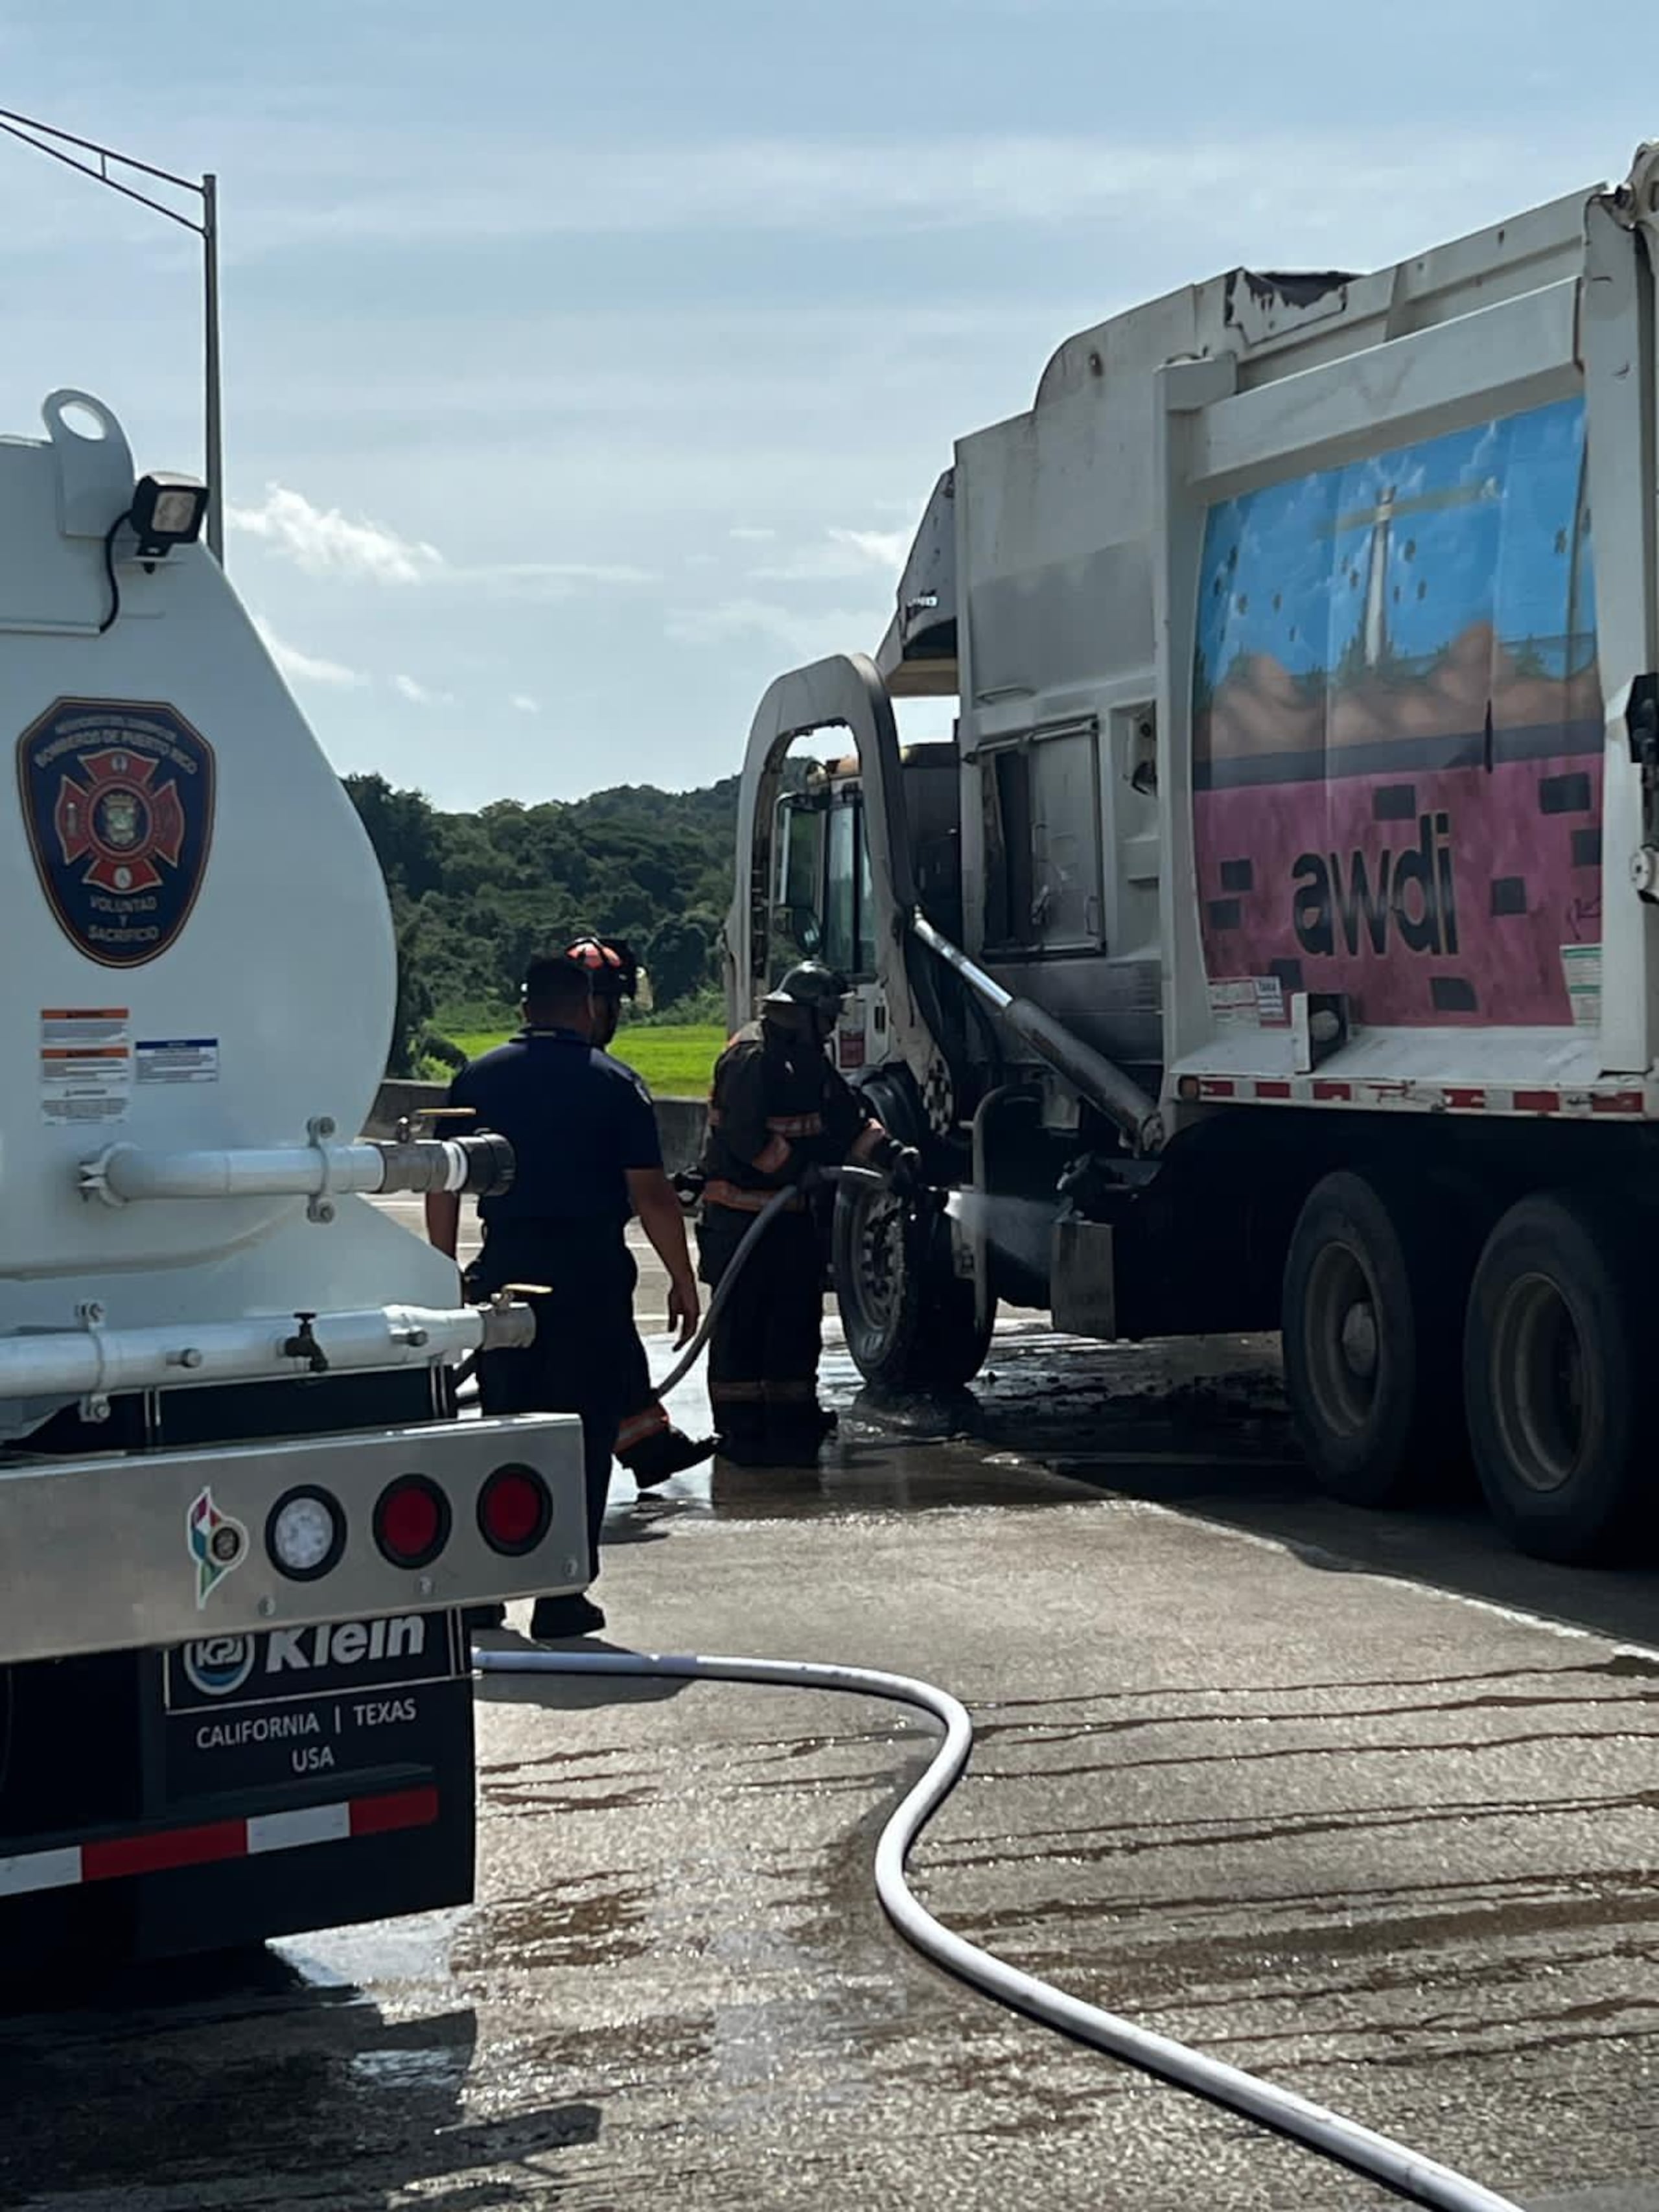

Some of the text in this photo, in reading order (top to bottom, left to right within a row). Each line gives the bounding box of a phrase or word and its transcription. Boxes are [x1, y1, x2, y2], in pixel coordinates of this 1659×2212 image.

[103, 729, 121, 745] DE
[121, 729, 170, 756] PUERTO
[168, 747, 198, 775] RICO
[89, 895, 157, 914] VOLUNTAD
[1292, 813, 1459, 956] awdi
[88, 925, 159, 942] SACRIFICIO
[265, 1614, 425, 1673] Klein
[196, 1712, 320, 1749] CALIFORNIA
[353, 1697, 417, 1727] TEXAS
[292, 1746, 335, 1772] USA
